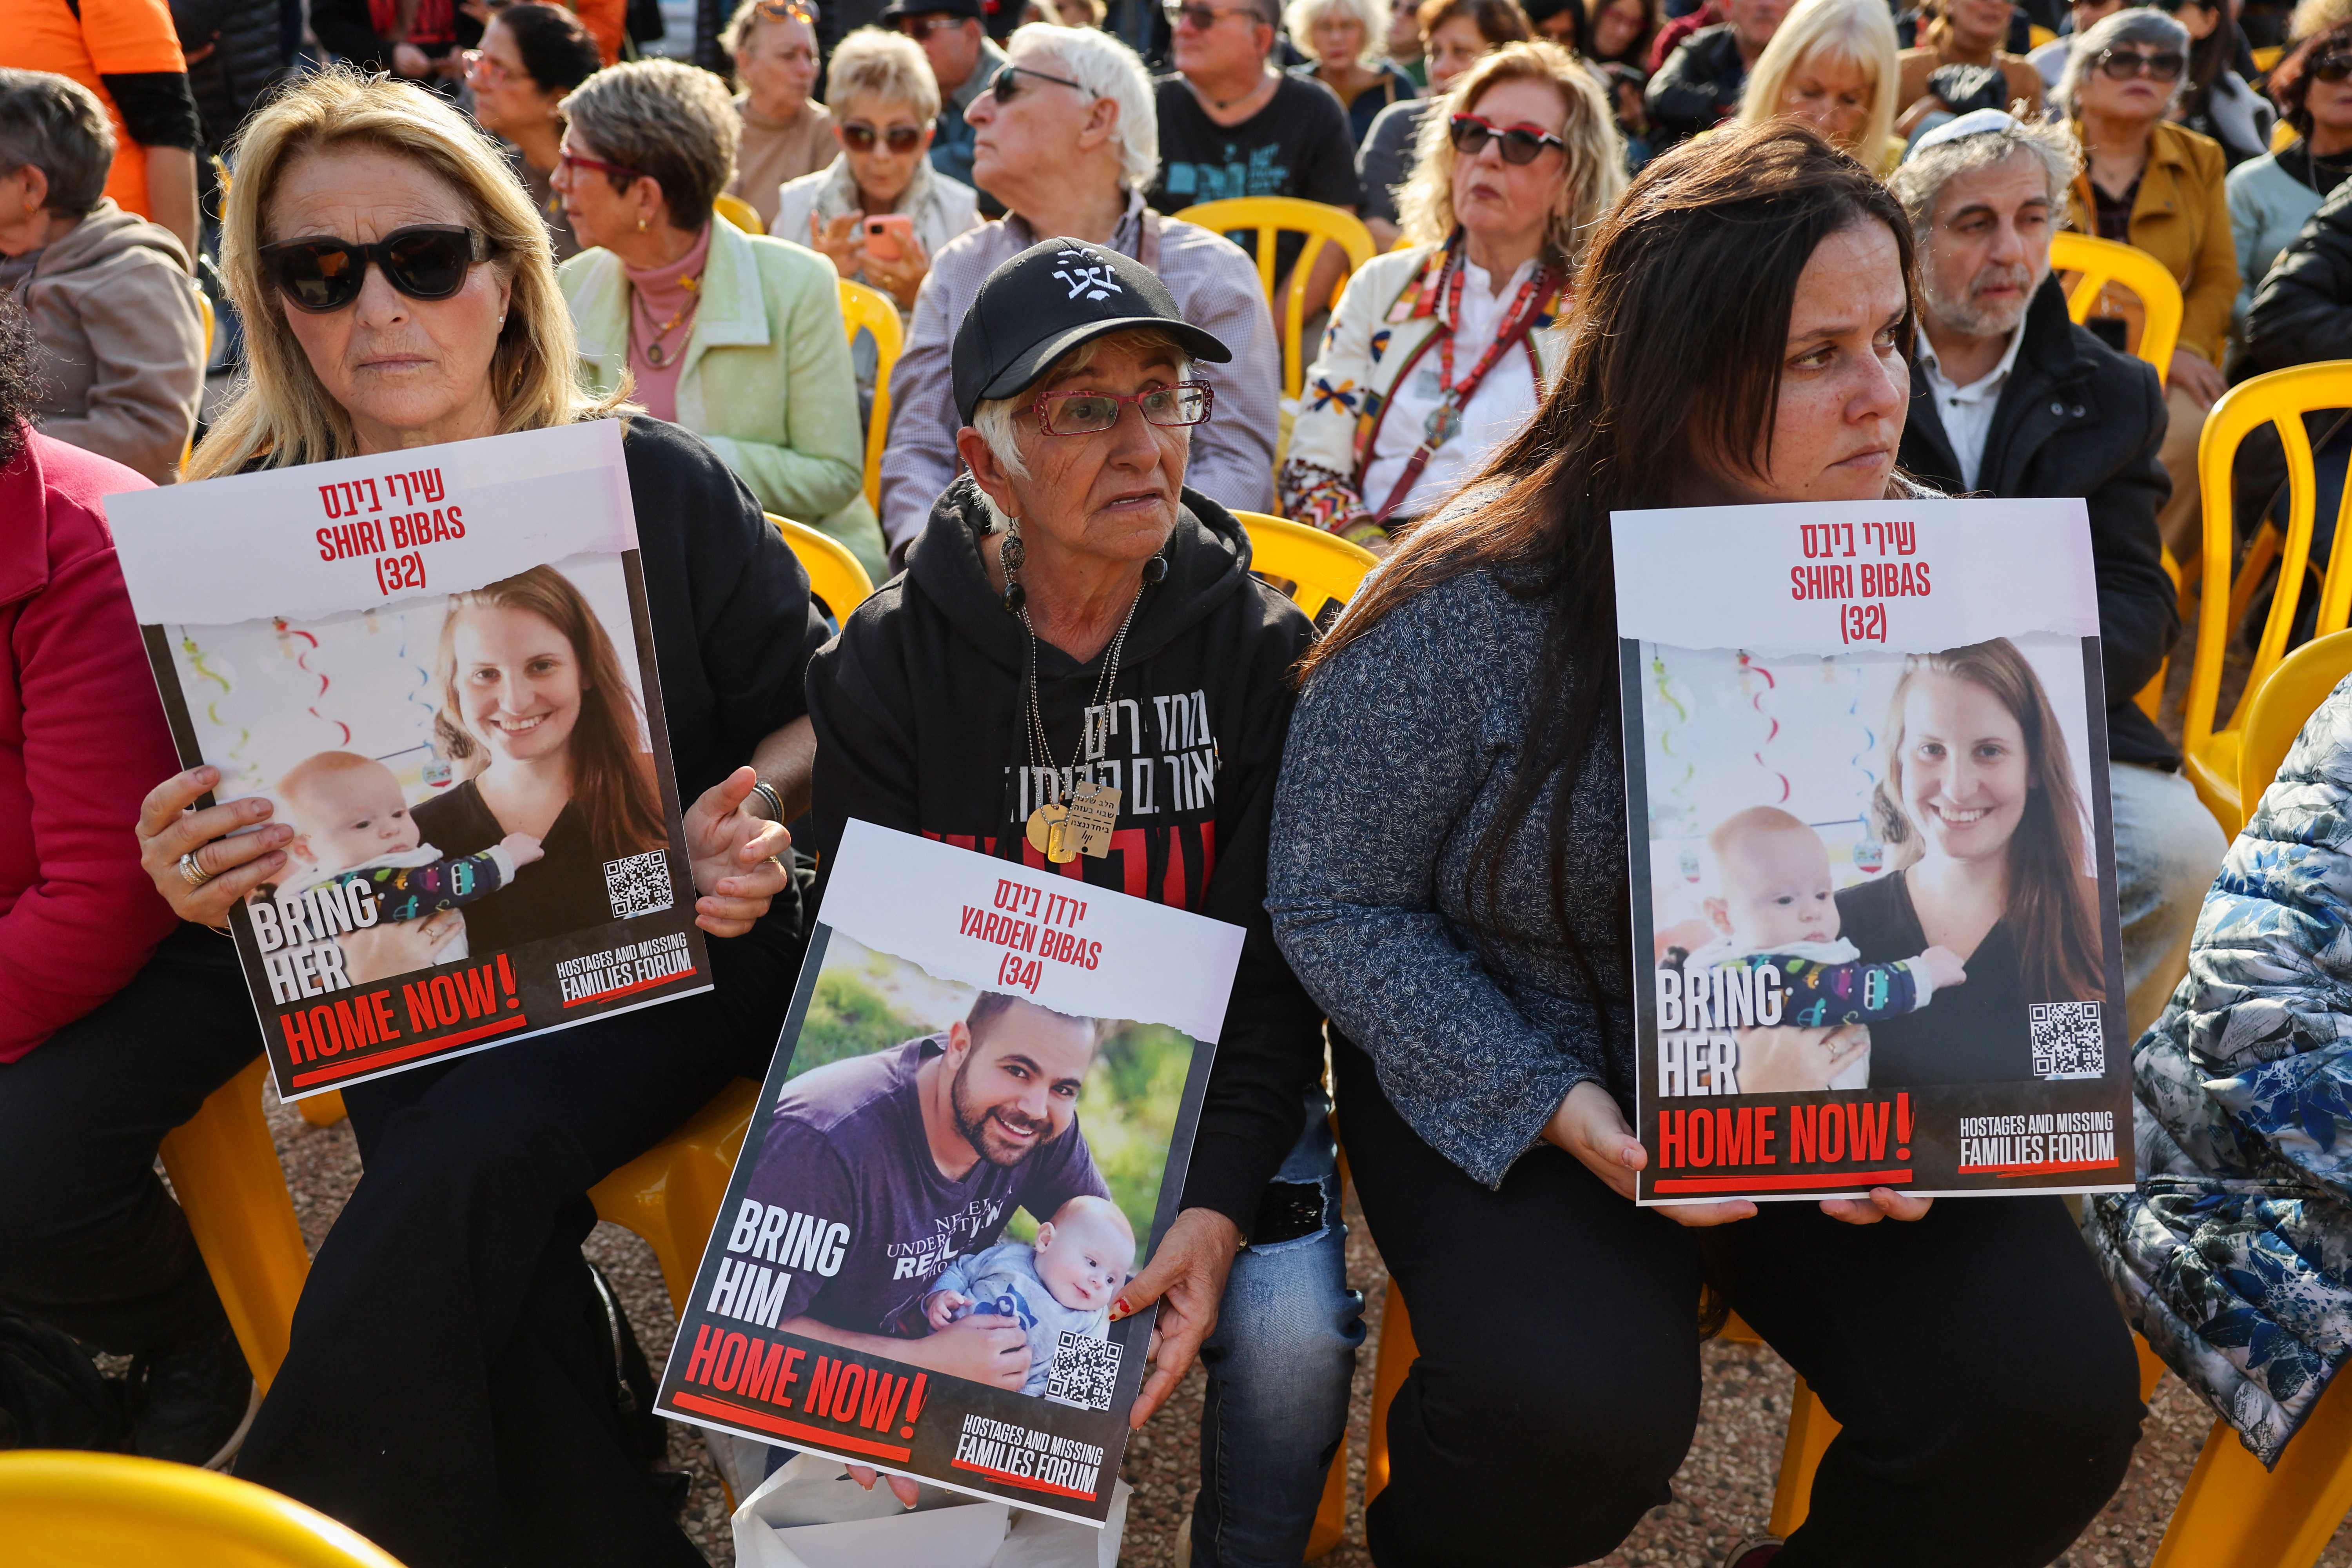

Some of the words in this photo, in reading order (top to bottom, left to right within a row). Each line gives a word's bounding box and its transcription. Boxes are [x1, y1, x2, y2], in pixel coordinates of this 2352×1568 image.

[318, 478, 383, 519] ביבס
[385, 468, 445, 506] שירי
[316, 519, 386, 561] SHIRI
[389, 506, 465, 549] BIBAS
[1800, 523, 1856, 558] ביבס
[1862, 522, 1916, 556] שירי
[376, 551, 426, 595] (32)
[1791, 564, 1853, 600] SHIRI
[1861, 562, 1931, 597] BIBAS
[1841, 603, 1886, 644] (32)
[1084, 689, 1211, 761] מחזרים
[1074, 804, 1093, 814] בעזה
[1097, 809, 1114, 818] שבוי
[1098, 800, 1114, 809] הלב
[247, 878, 378, 953] BRING
[994, 878, 1042, 918] ביבס
[1044, 893, 1087, 928] ירדן
[556, 951, 612, 978] HOSTAGES
[615, 944, 637, 964] AND
[638, 932, 687, 958] MISSING
[960, 905, 1038, 953] YARDEN
[1038, 928, 1102, 970] BIBAS
[263, 943, 351, 1005] HER
[560, 963, 633, 1002] FAMILIES
[635, 947, 692, 983] FORUM
[998, 952, 1042, 995] (34)
[1655, 964, 1782, 1029] BRING
[280, 990, 400, 1065] HOME
[402, 953, 519, 1033] NOW!
[1657, 1035, 1738, 1097] HER
[1659, 1107, 1776, 1168] HOME
[1790, 1092, 1916, 1163] NOW!
[1960, 1115, 2025, 1137] HOSTAGES
[2028, 1114, 2053, 1134] AND
[2056, 1111, 2113, 1132] MISSING
[1961, 1136, 2043, 1166] FAMILIES
[2049, 1132, 2114, 1163] FORUM
[727, 1198, 850, 1277] BRING
[706, 1257, 791, 1329] HIM
[684, 1323, 806, 1407] HOME
[804, 1355, 931, 1439] NOW!
[963, 1414, 1024, 1446] HOSTAGES
[1024, 1429, 1050, 1452] AND
[1050, 1436, 1103, 1466] MISSING
[955, 1433, 1035, 1478] FAMILIES
[1034, 1454, 1099, 1494] FORUM
